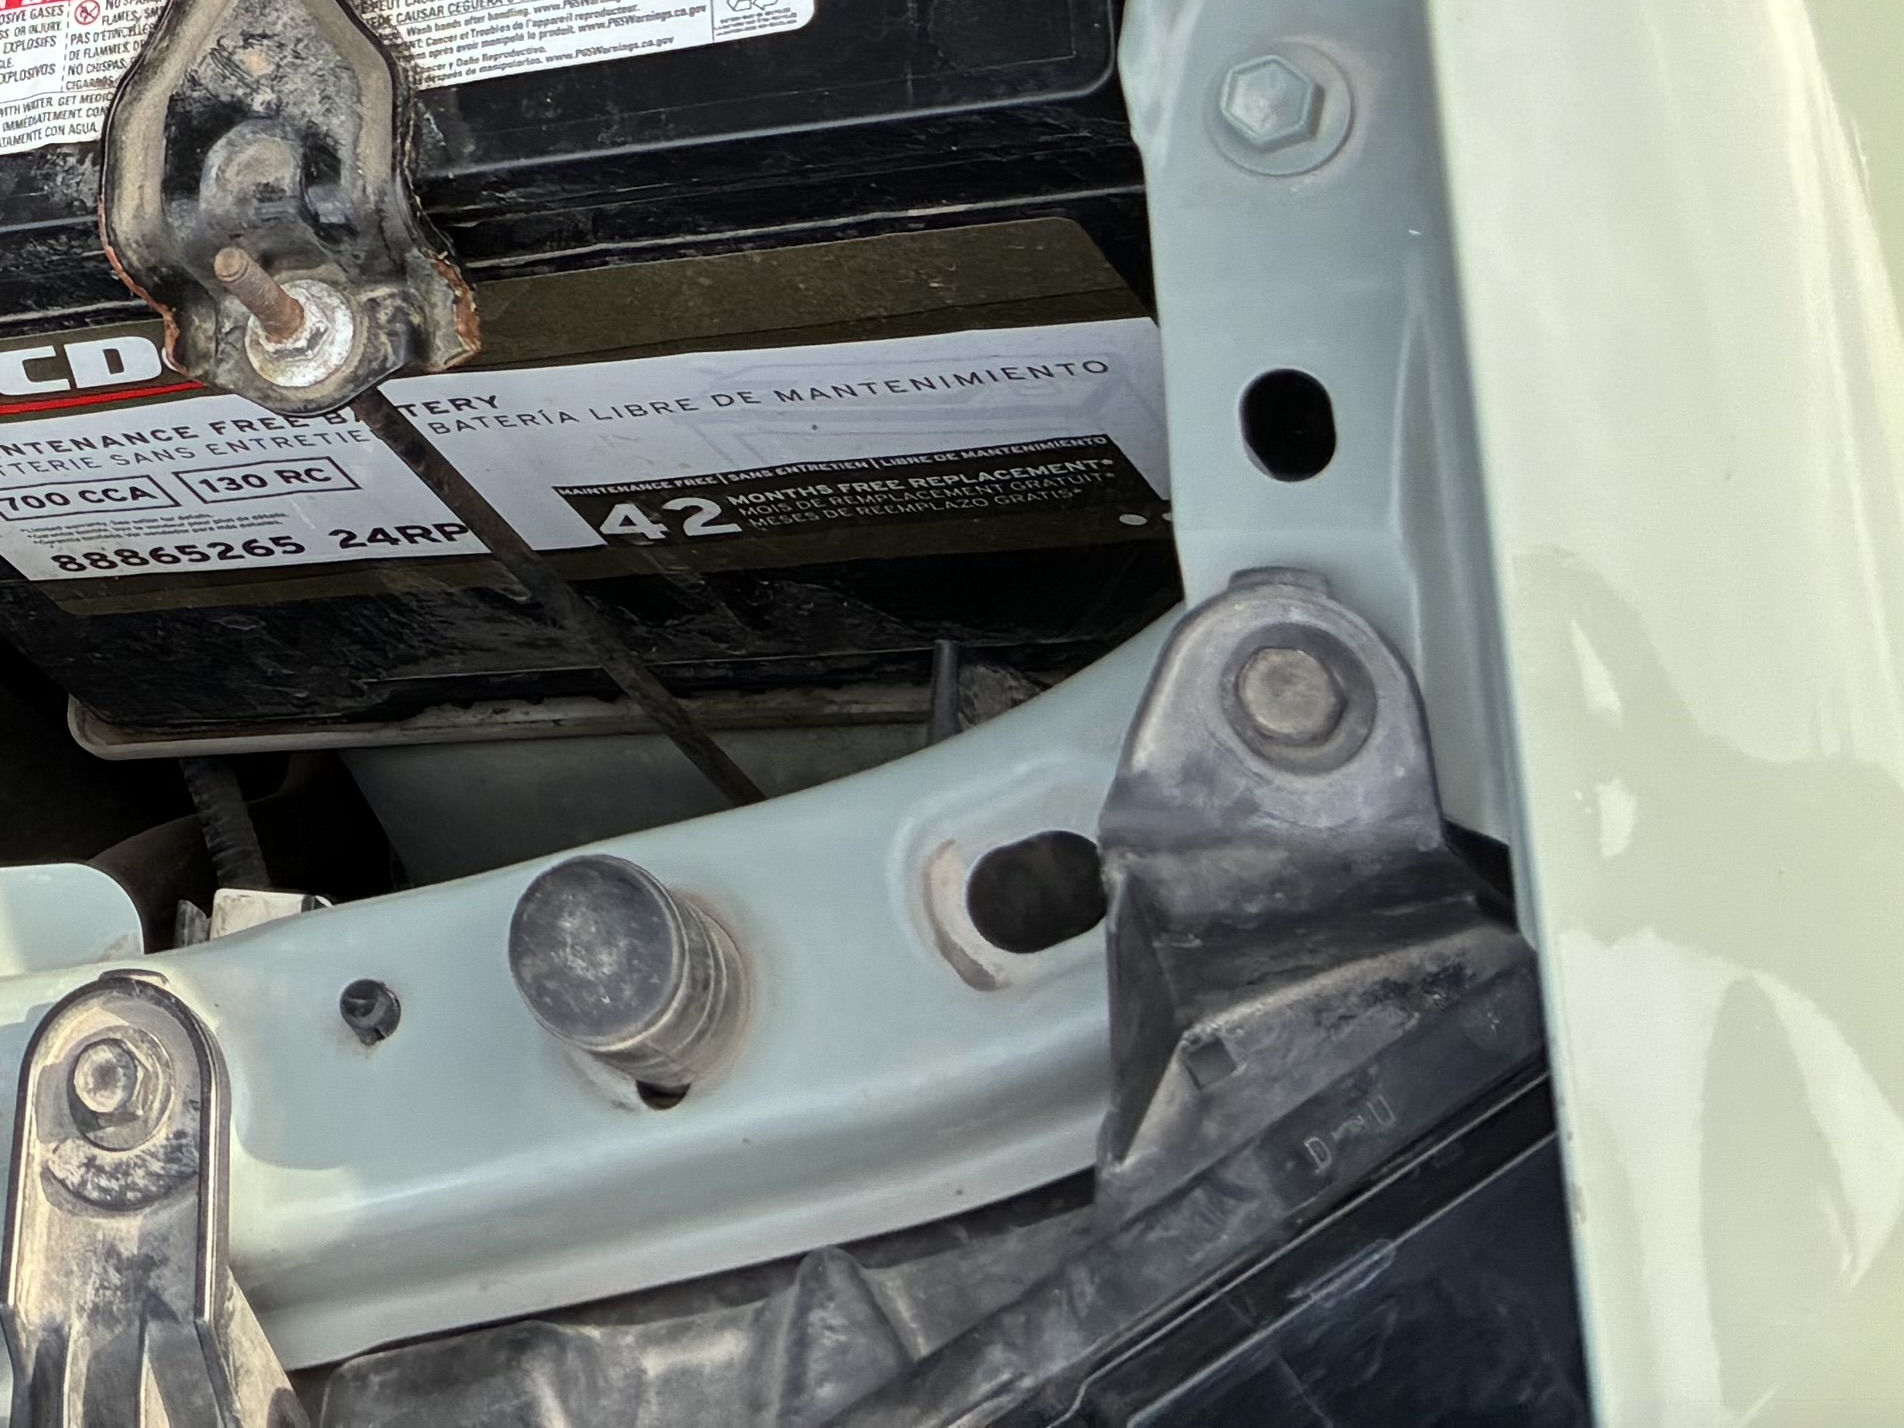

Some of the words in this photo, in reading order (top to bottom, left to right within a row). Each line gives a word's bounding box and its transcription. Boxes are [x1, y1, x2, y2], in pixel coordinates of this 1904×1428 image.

[30, 3, 64, 21] GASES
[395, 4, 444, 23] CAUSAR
[2, 34, 57, 54] EXPLOSIFS
[427, 408, 581, 437] BATERÍA
[589, 395, 701, 422] LIBRE
[710, 389, 762, 409] DE
[772, 358, 1112, 404] MANTENIMIENTO
[208, 416, 302, 437] FREE
[111, 445, 198, 469] SANS
[206, 428, 383, 458] ENTRETIE
[76, 484, 160, 506] CCA
[198, 471, 269, 495] 130
[276, 465, 333, 487] RC
[558, 480, 672, 497] MAINTENANCE
[728, 481, 832, 506] MONTHS
[838, 477, 904, 495] FREE
[740, 500, 793, 517] MOIS
[797, 497, 824, 512] DE
[827, 480, 1005, 507] REMPLACEMENT
[599, 496, 744, 541] 42
[748, 511, 817, 529] MESES
[823, 507, 851, 521] DE
[855, 496, 989, 519] REEMPLAZO
[50, 534, 307, 574] 88865265
[329, 522, 476, 552] 24RP
